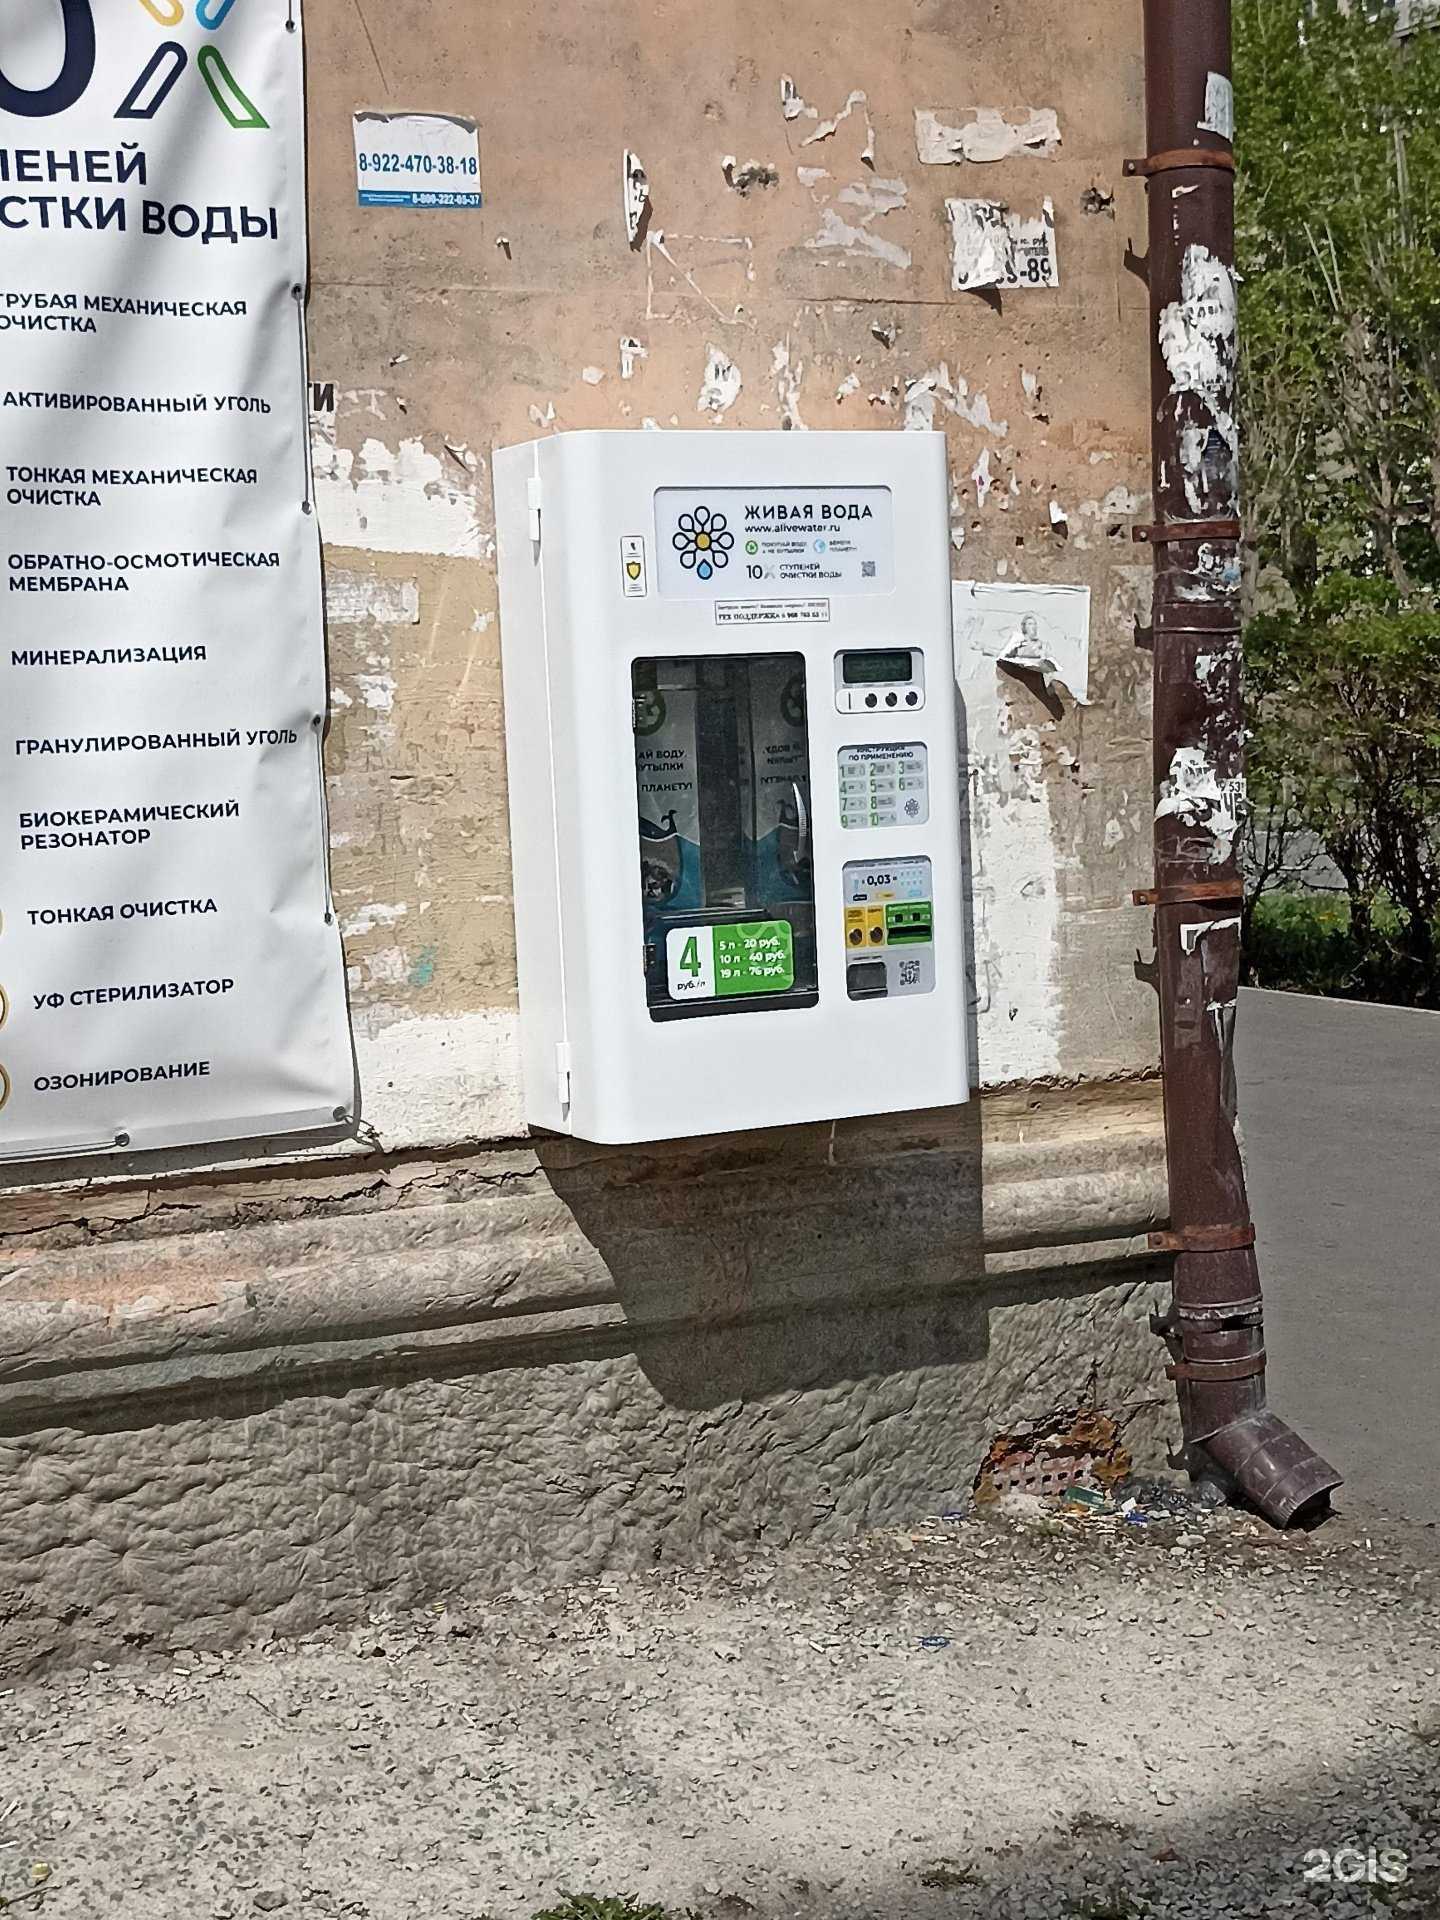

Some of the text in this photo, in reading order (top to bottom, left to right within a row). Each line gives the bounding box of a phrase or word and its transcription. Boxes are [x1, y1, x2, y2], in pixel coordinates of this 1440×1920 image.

[359, 153, 478, 175] 8-922-470-38-18
[0, 195, 278, 244] СТКИ ВОДЫ
[84, 295, 247, 317] МЕХАНИЧЕСКАЯ
[0, 315, 97, 333] ОЧИСТКА
[3, 391, 271, 414] АКТИВИРОВАННЫЙ УГОЛЬ
[6, 466, 257, 485] ТОНКАЯ МЕХАНИЧЕСКАЯ
[7, 489, 101, 506] ОЧИСТКА
[745, 504, 873, 520] ЖИВАЯ ВОДА
[745, 523, 841, 533] www.alivewater.ru
[8, 551, 280, 571] ОБРАТНО-ОСМОТИЧЕСКАЯ
[779, 563, 820, 571] СТУПЕНЕЙ
[746, 564, 763, 580] 10
[780, 571, 817, 579] ОЧИСТКИ
[9, 576, 129, 592] МЕМБРАНА
[11, 645, 207, 666] МИНЕРАЛИЗАЦИЯ
[15, 729, 298, 756] ГРАНУЛИРОВАННЫЙ УГОЛЬ
[861, 752, 914, 760] ПРИМЕНЕНИЮ
[870, 763, 876, 776] 2
[899, 761, 905, 774] 3
[870, 779, 877, 792] 5
[19, 800, 240, 828] БИОКЕРАМИЧЕСКИЙ
[21, 829, 151, 850] РЕЗОНАТОР
[867, 874, 891, 886] 0,03
[28, 899, 218, 925] ТОНКАЯ ОЧИСТКА
[720, 941, 726, 950] 5
[744, 938, 757, 948] 20
[679, 936, 702, 977] 4
[720, 955, 731, 964] 10
[749, 951, 763, 961] 40
[720, 968, 731, 978] 19
[749, 966, 762, 976] 76
[33, 978, 234, 1010] УФ СТЕРИЛИЗАТОР
[34, 1061, 210, 1091] ОЗОНИРОВАНИЕ
